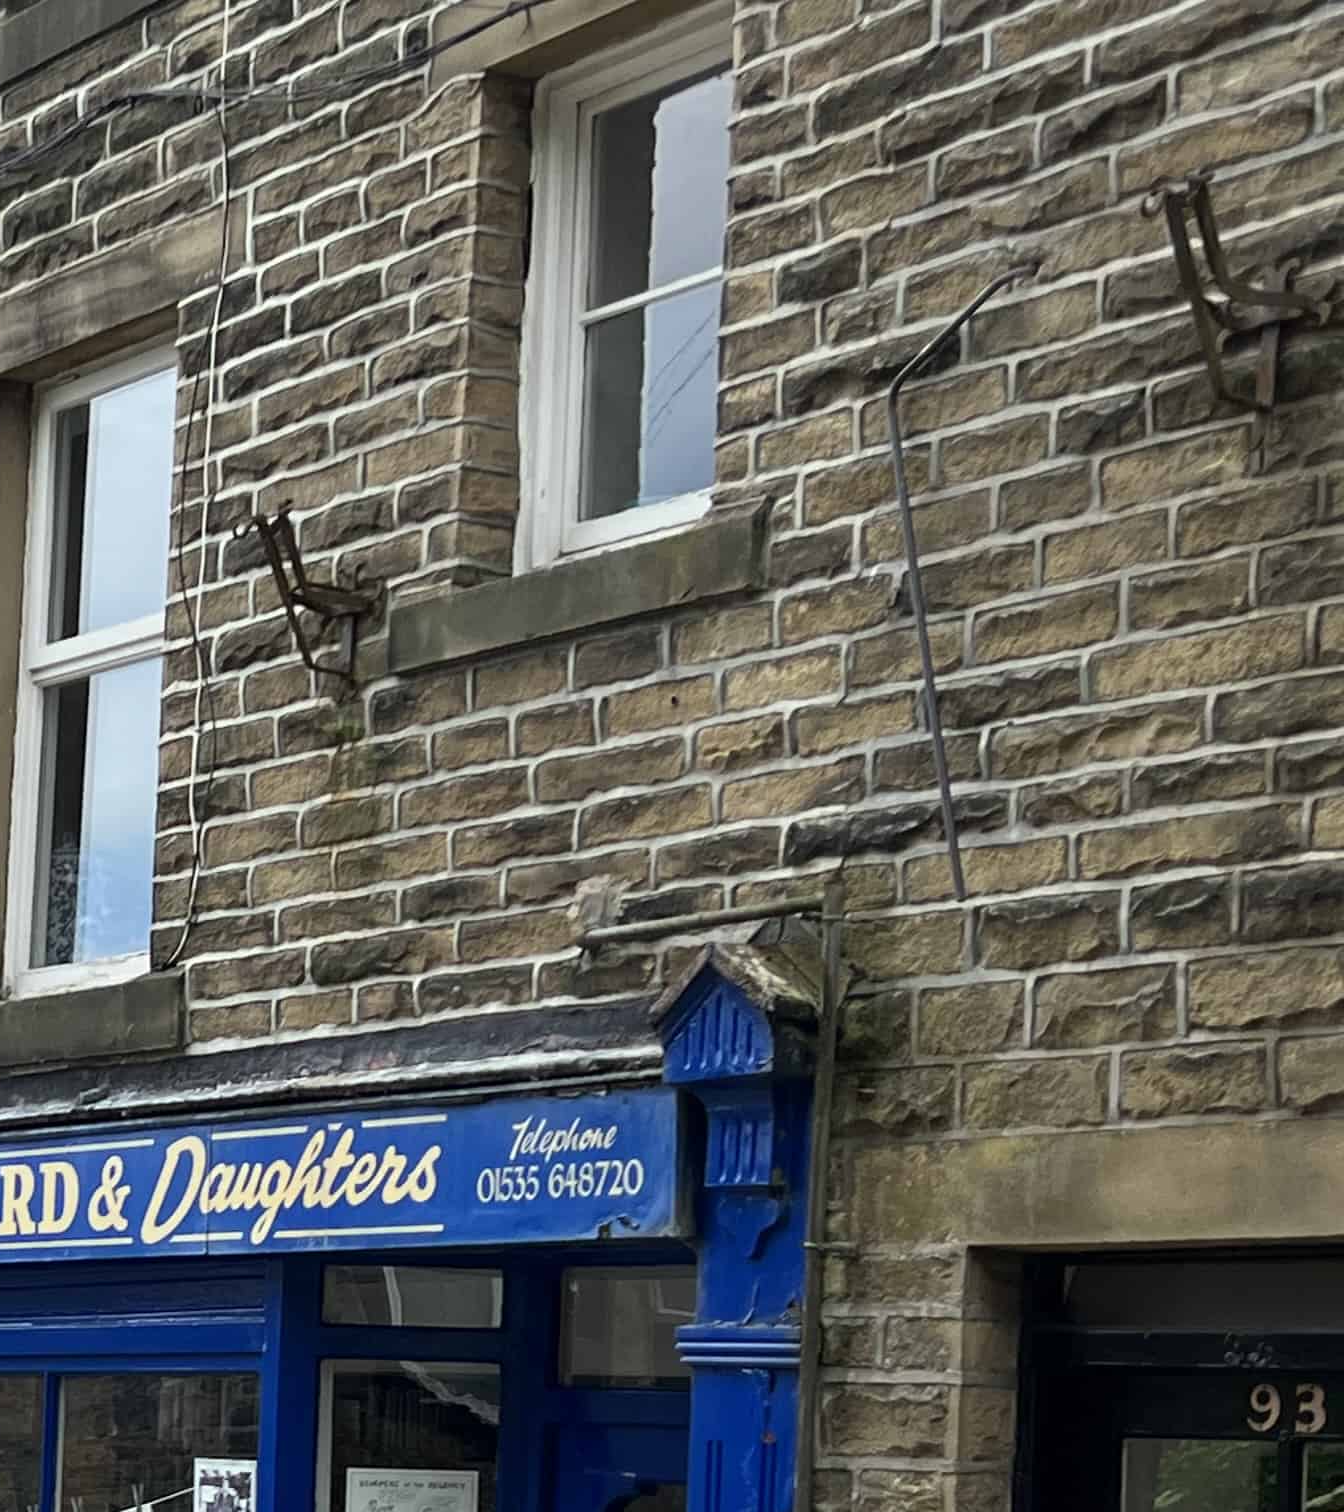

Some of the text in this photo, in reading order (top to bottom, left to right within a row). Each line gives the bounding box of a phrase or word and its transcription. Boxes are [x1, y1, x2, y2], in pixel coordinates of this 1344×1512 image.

[509, 1117, 618, 1161] Telephone
[87, 1155, 131, 1232] &
[141, 1126, 443, 1245] Daughters
[476, 1158, 644, 1203] 01535 648720
[1246, 1383, 1327, 1433] 93
